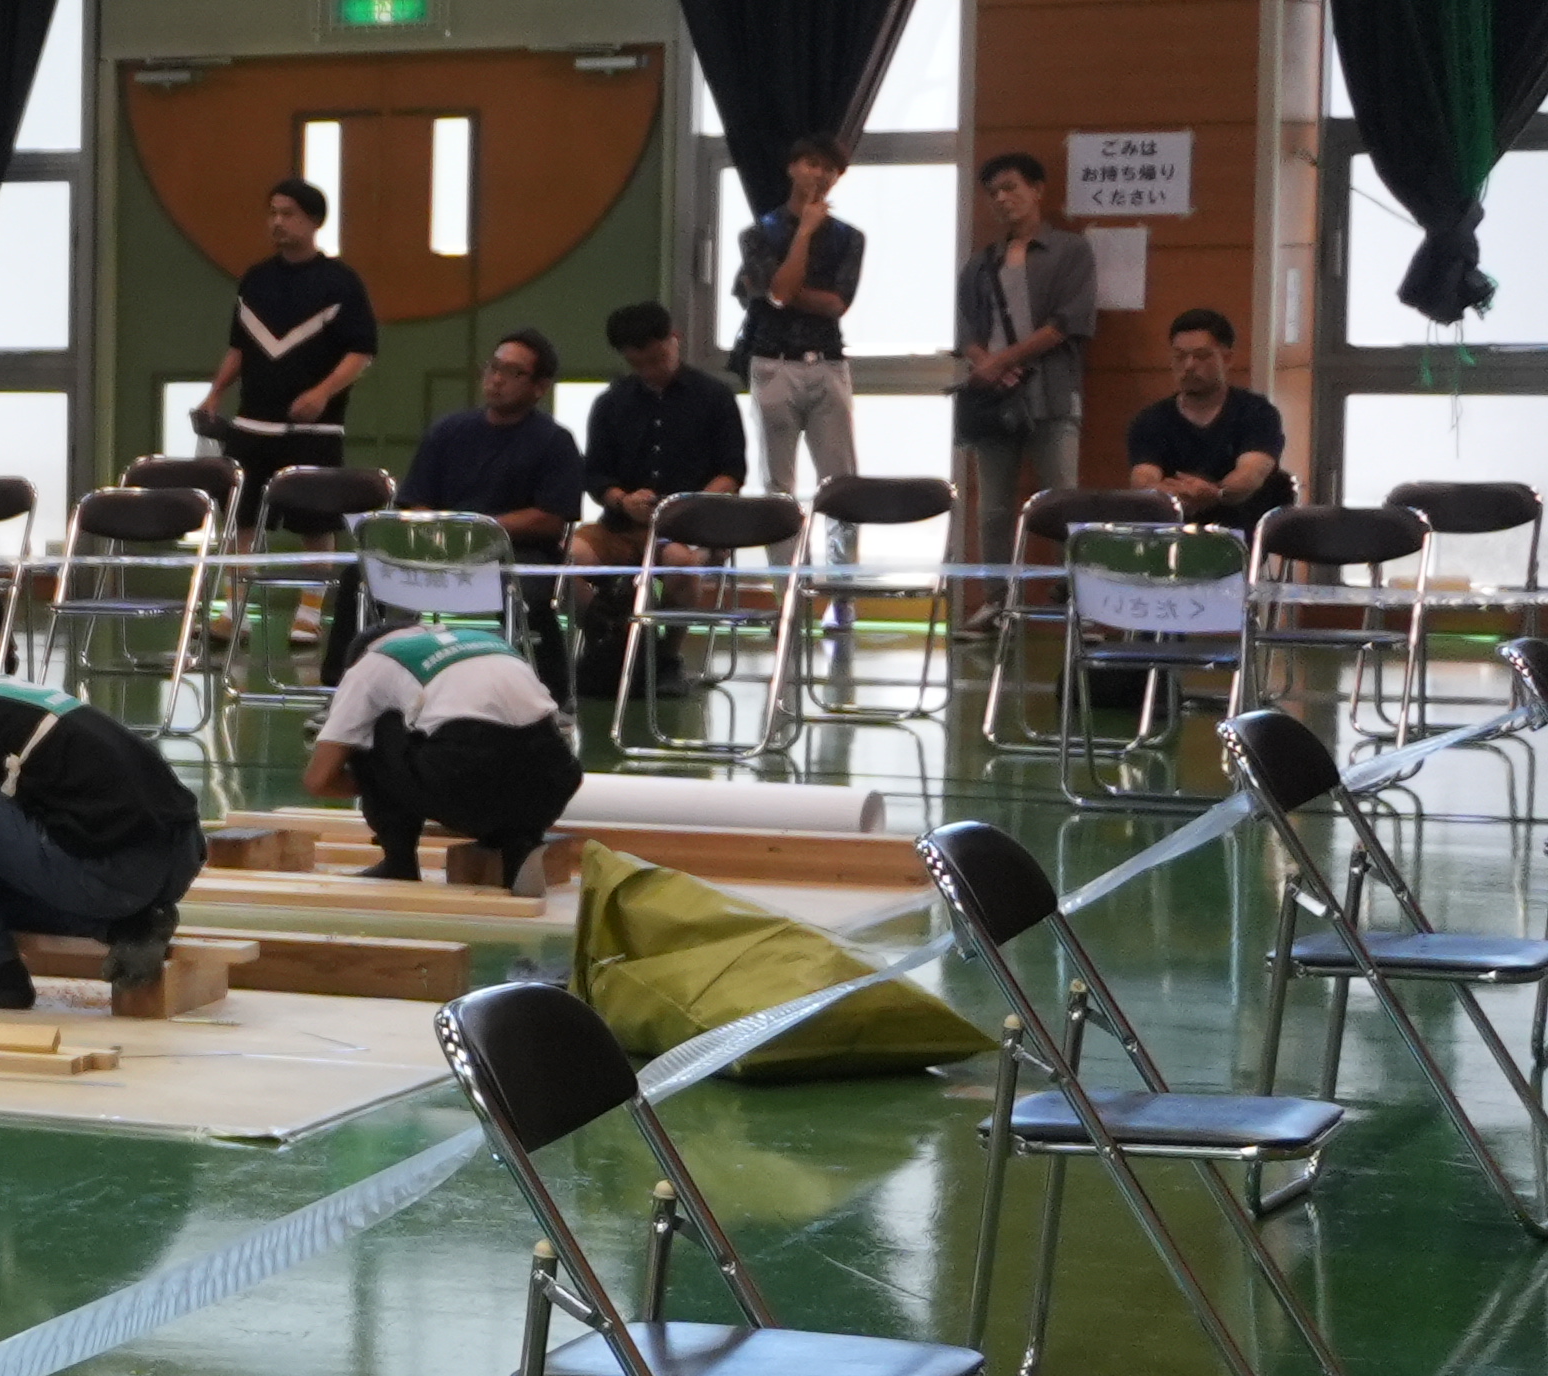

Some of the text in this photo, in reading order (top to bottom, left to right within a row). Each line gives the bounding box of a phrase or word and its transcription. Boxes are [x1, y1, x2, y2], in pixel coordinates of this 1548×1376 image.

[1081, 164, 1176, 183] お持ち帰り
[1091, 188, 1167, 207] ください
